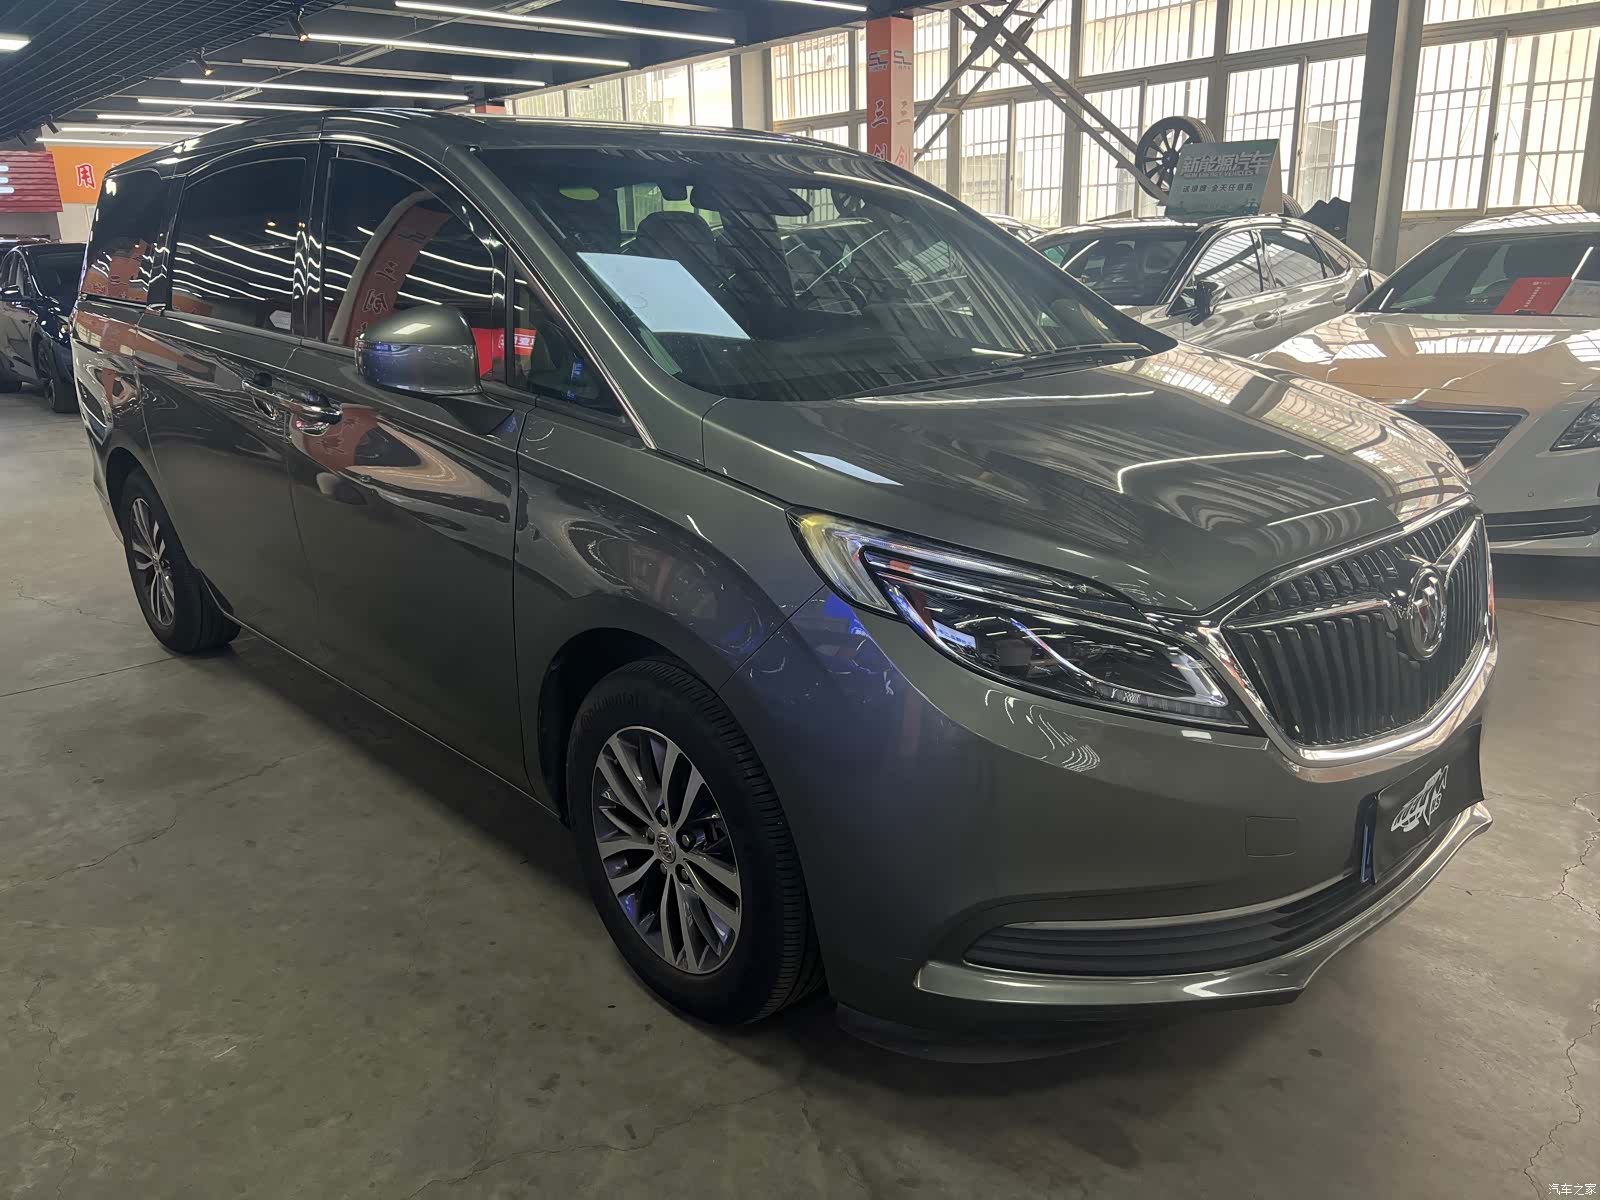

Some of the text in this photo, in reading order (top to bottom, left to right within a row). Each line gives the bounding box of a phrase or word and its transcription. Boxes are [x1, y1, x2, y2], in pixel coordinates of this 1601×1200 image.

[1182, 151, 1271, 174] 新能源汽车
